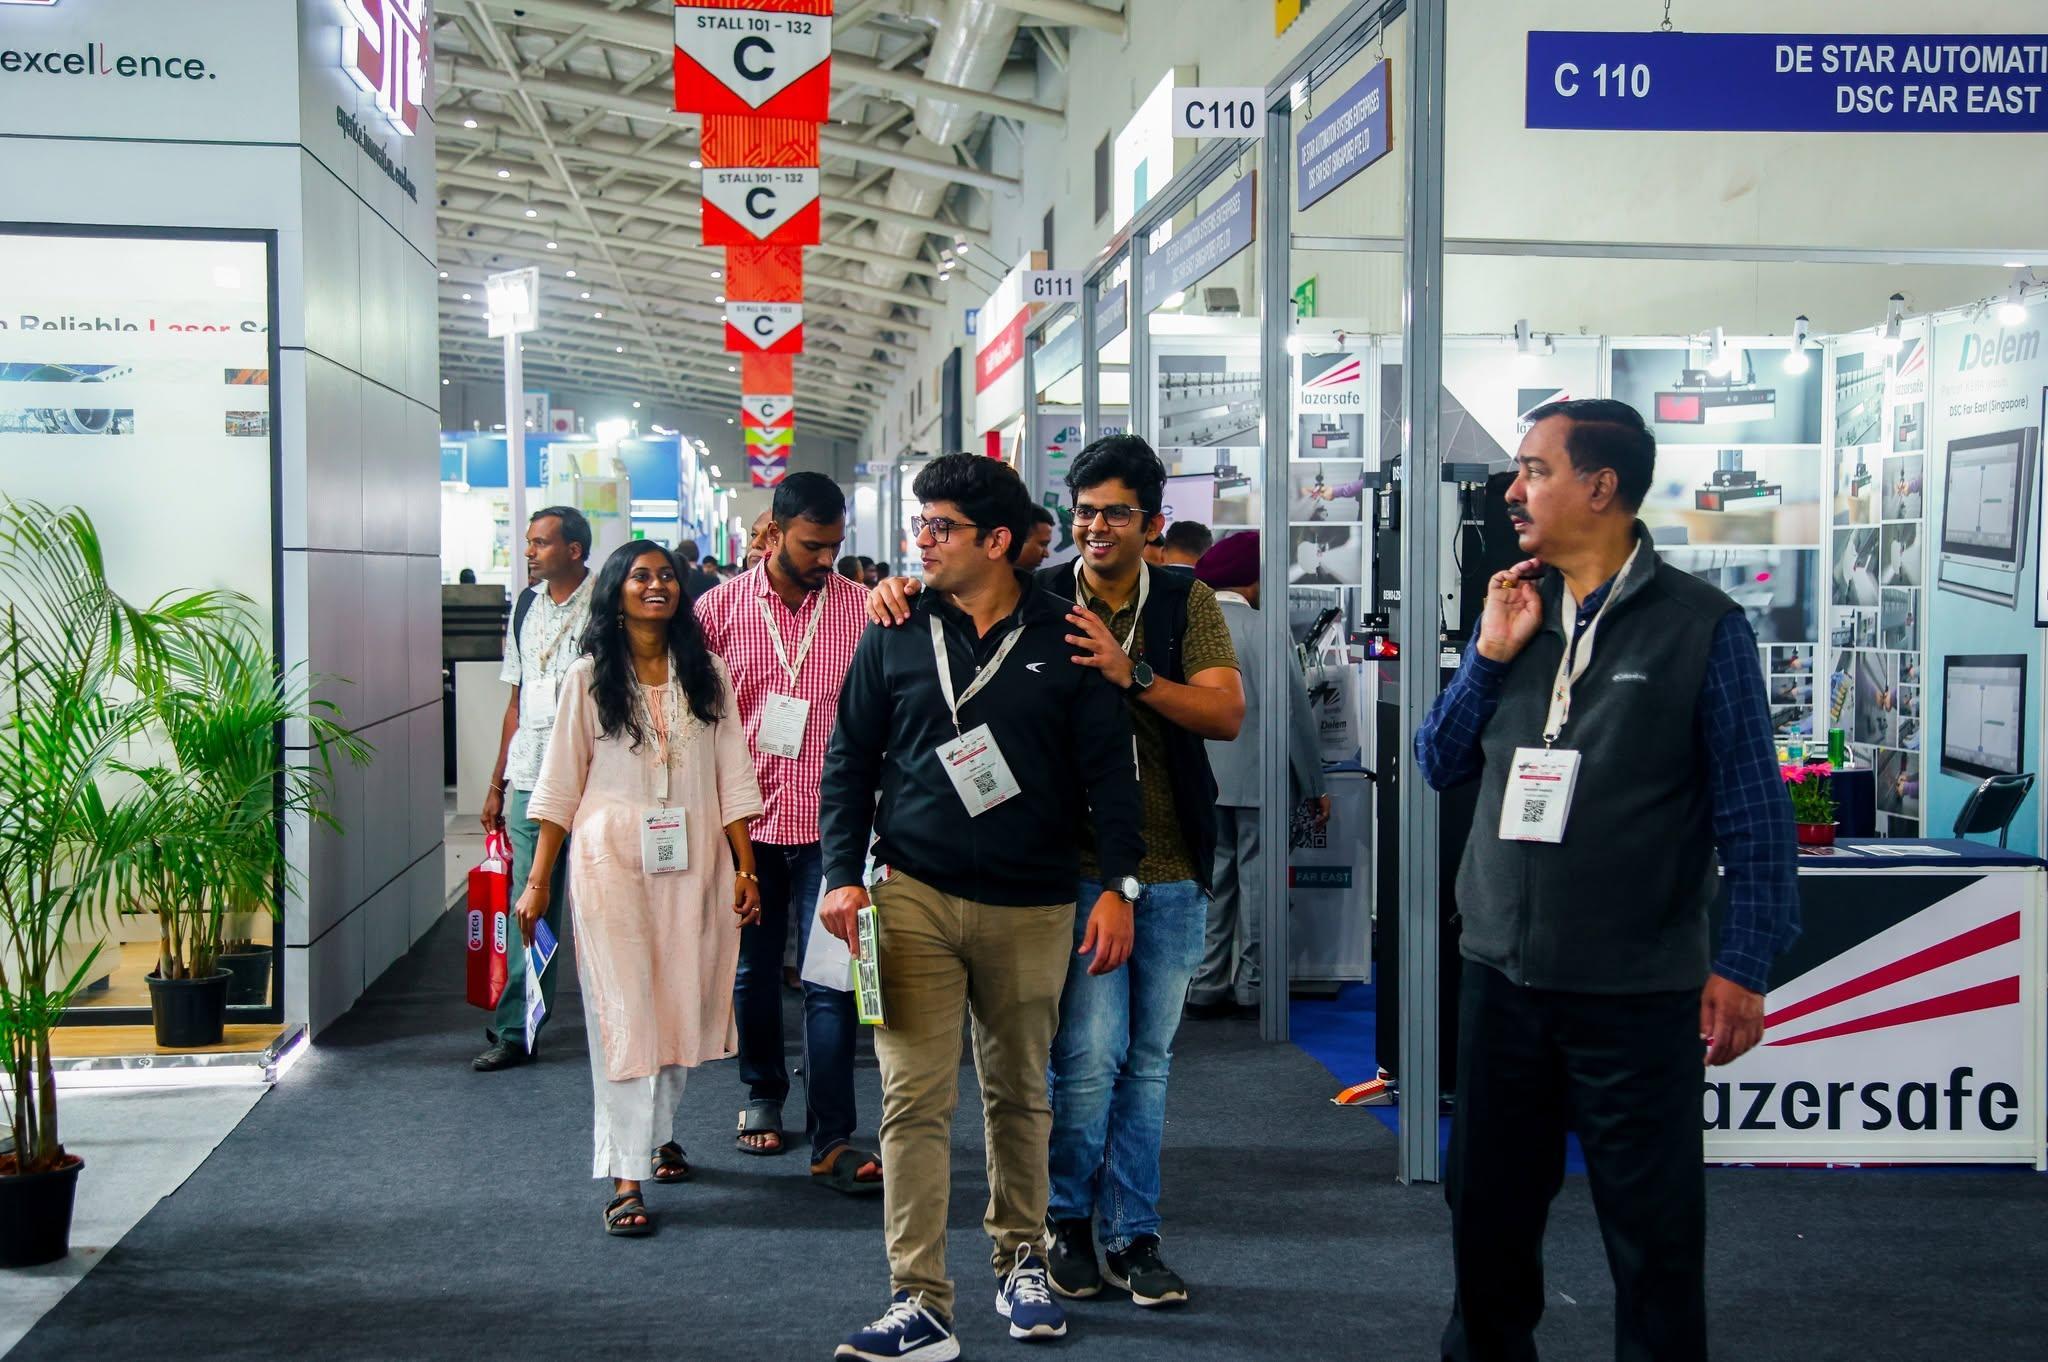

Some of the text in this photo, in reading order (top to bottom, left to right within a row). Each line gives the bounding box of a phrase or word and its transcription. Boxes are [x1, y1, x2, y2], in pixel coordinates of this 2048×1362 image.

[697, 15, 744, 30] STALL
[748, 17, 769, 32] 101
[787, 20, 812, 35] 132
[0, 42, 217, 80] excellence.
[733, 36, 775, 82] C
[1775, 44, 2048, 74] DE STAR AUTOMATI
[1553, 62, 1651, 98] C 110
[1836, 85, 2042, 114] DSC FAR EAST
[1185, 100, 1255, 129] C110
[719, 173, 753, 184] STALL
[755, 173, 773, 183] 101
[785, 173, 804, 183] 132
[745, 187, 776, 220] C
[1034, 277, 1072, 296] C111
[754, 315, 773, 336] C
[1959, 328, 2041, 371] Delem
[761, 403, 774, 418] C
[1301, 391, 1360, 405] lazersafe
[1949, 404, 1962, 417] DSC
[1974, 401, 1988, 414] East
[1988, 394, 2029, 415] (Singapore)
[1296, 871, 1351, 883] FAR EAST
[1703, 1066, 2019, 1131] azersafe
